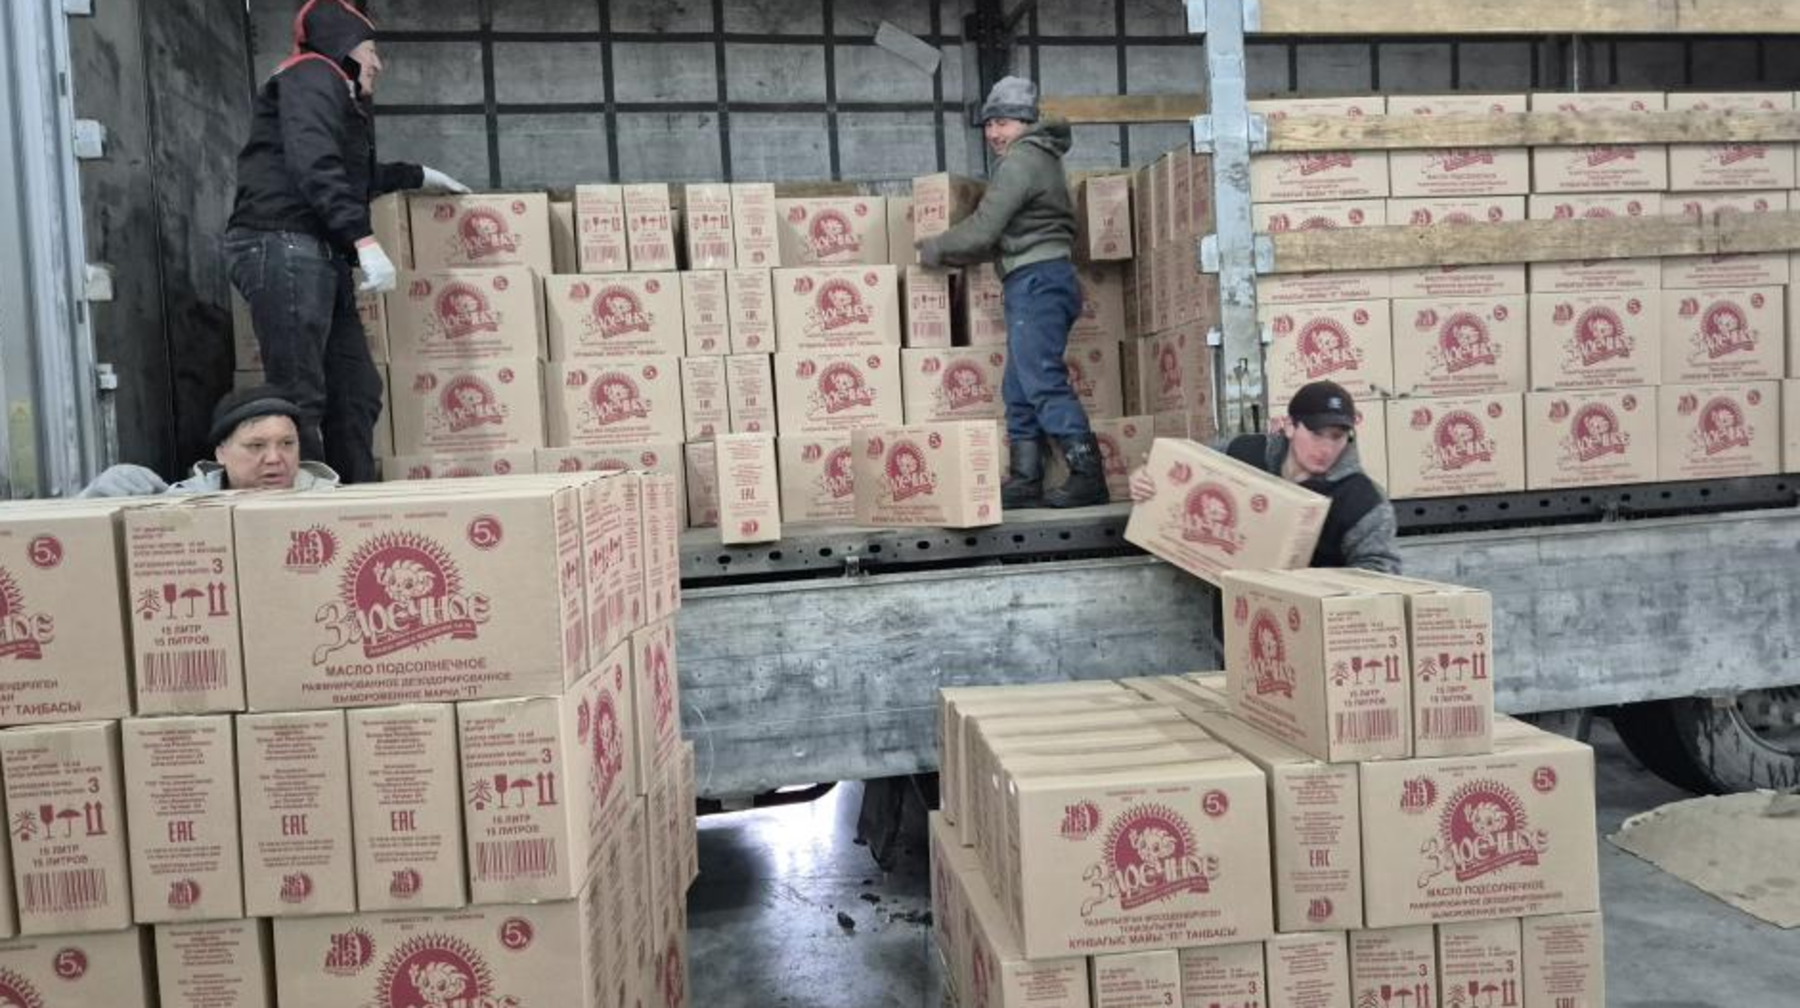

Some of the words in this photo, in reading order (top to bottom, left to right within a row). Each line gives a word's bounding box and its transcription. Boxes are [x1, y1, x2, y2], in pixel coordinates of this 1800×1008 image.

[212, 558, 224, 574] 3
[175, 625, 202, 634] ЛИТР
[167, 636, 210, 646] ЛИТРОВ
[1389, 636, 1397, 649] 3
[1476, 632, 1485, 645] 3
[325, 663, 373, 677] МАСЛО
[377, 657, 487, 676] ПОДСОЛНЕЧНОЕ
[302, 678, 400, 692] РАФИНИРОВАННОЕ
[400, 672, 512, 688] ДЕЗОДОРИРОВАННОЕ
[542, 748, 552, 764] 3
[88, 777, 99, 793] 3
[282, 814, 308, 835] EAC
[391, 810, 416, 831] EAC
[504, 815, 530, 823] ЛИТР
[168, 821, 195, 842] EAC
[499, 825, 540, 835] ЛИТРОВ
[51, 845, 79, 854] ЛИТР
[46, 856, 88, 866] ЛИТРОВ
[1427, 886, 1462, 897] МАСЛО
[1464, 879, 1545, 896] ПОДСОЛНЕЧНОЕ
[1418, 964, 1427, 977] 3
[1506, 959, 1514, 973] 3
[1248, 981, 1257, 995] 3
[1164, 992, 1174, 1005] 3
